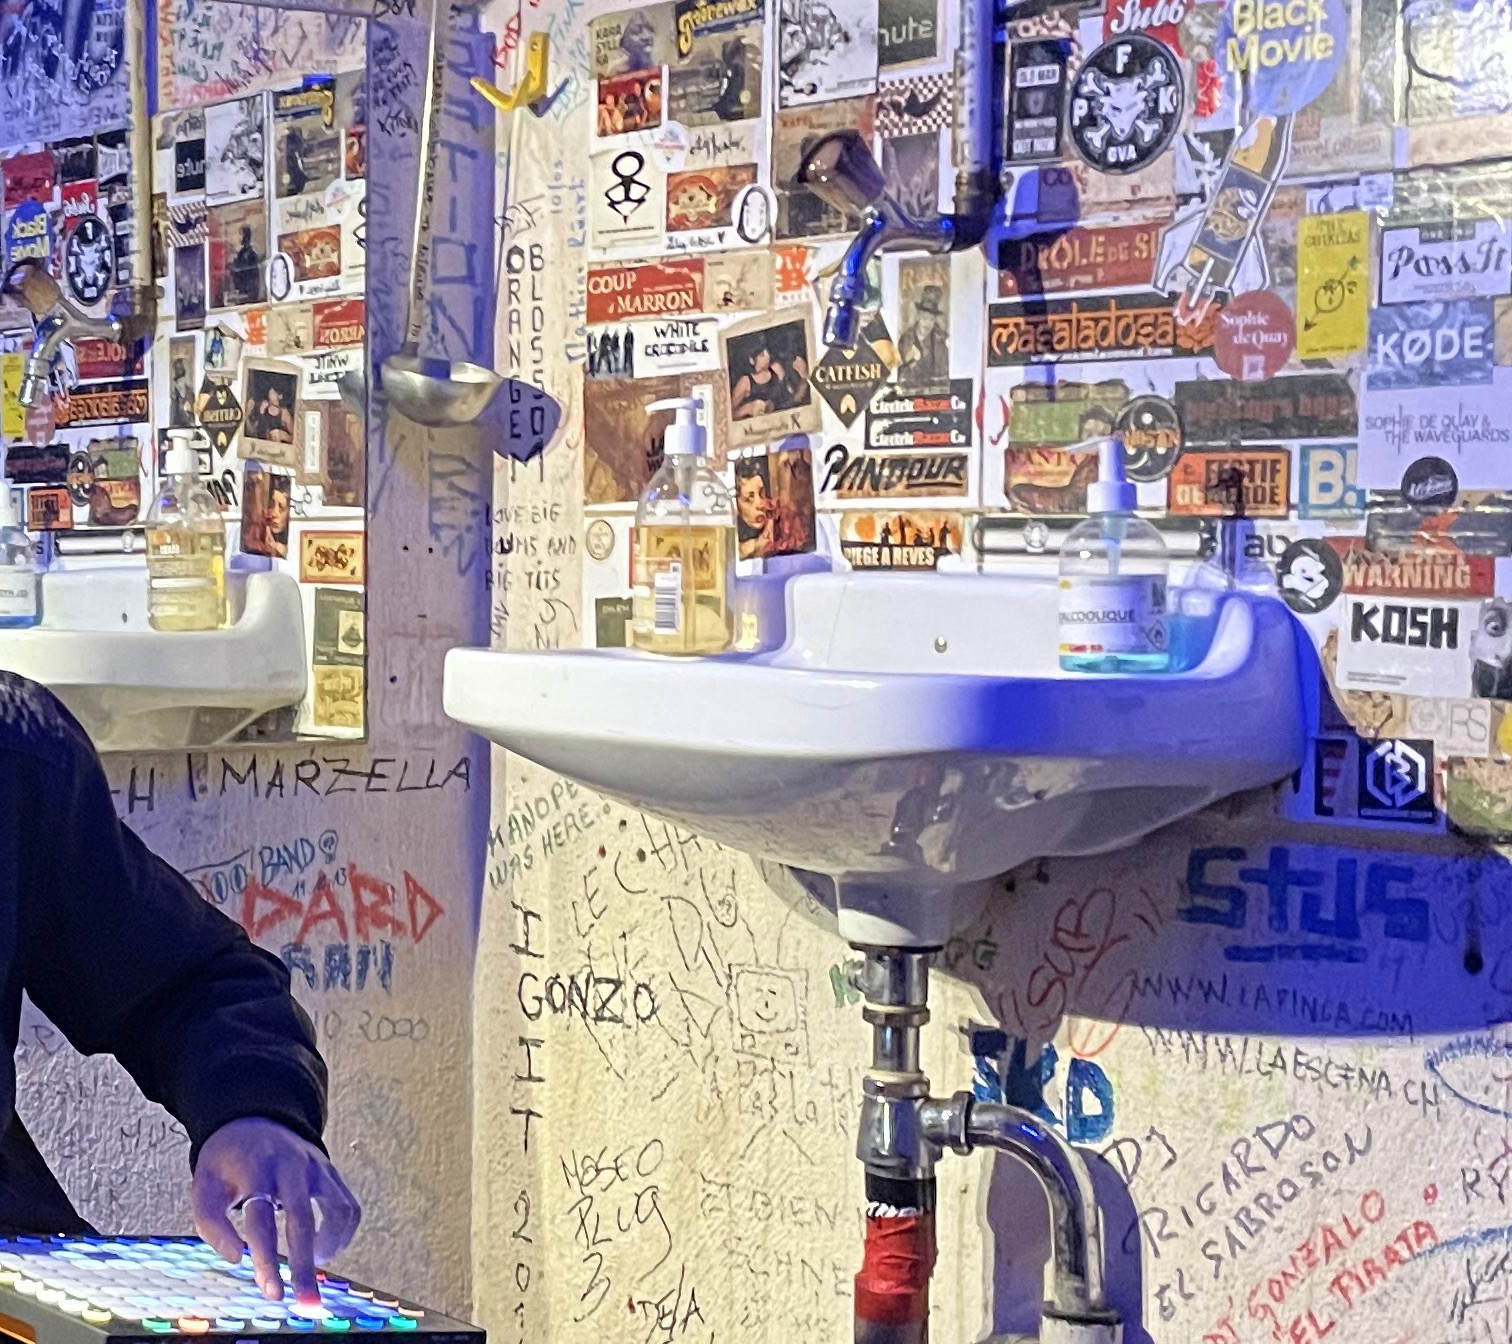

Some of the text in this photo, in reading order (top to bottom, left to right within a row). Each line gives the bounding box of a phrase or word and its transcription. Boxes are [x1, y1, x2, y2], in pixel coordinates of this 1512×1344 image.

[1226, 27, 1335, 73] Movie
[588, 271, 637, 295] COUP
[615, 289, 694, 314] MARRON
[505, 244, 527, 440] ORANGE
[1376, 325, 1485, 366] KØDE
[815, 362, 882, 386] CATFISH
[1419, 414, 1437, 430] DE
[1342, 561, 1472, 591] WARNING
[1350, 601, 1460, 650] KOSH
[219, 748, 472, 801] MARZELLA
[519, 974, 658, 1024] GONZO
